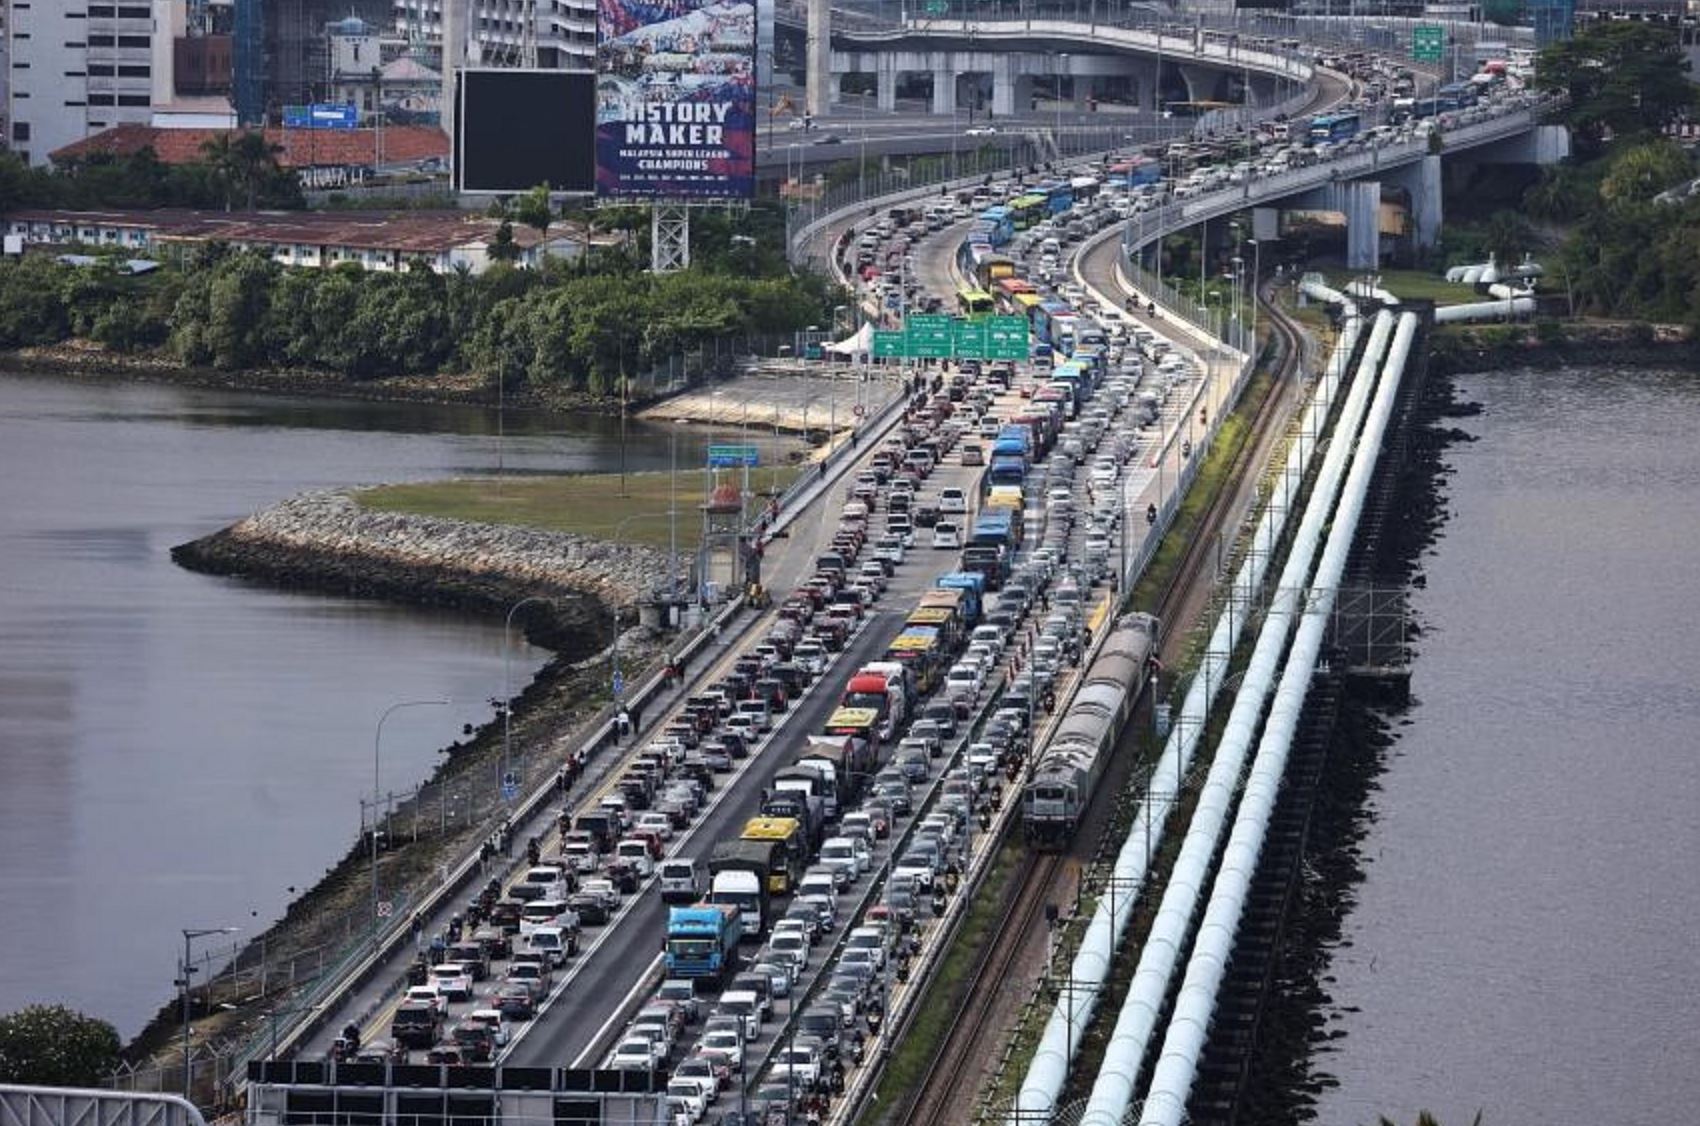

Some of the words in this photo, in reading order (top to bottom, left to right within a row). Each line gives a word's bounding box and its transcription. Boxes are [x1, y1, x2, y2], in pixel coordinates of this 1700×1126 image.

[624, 101, 732, 122] HISTORY
[625, 124, 723, 145] MAKER
[638, 160, 709, 170] CHAMPIONS
